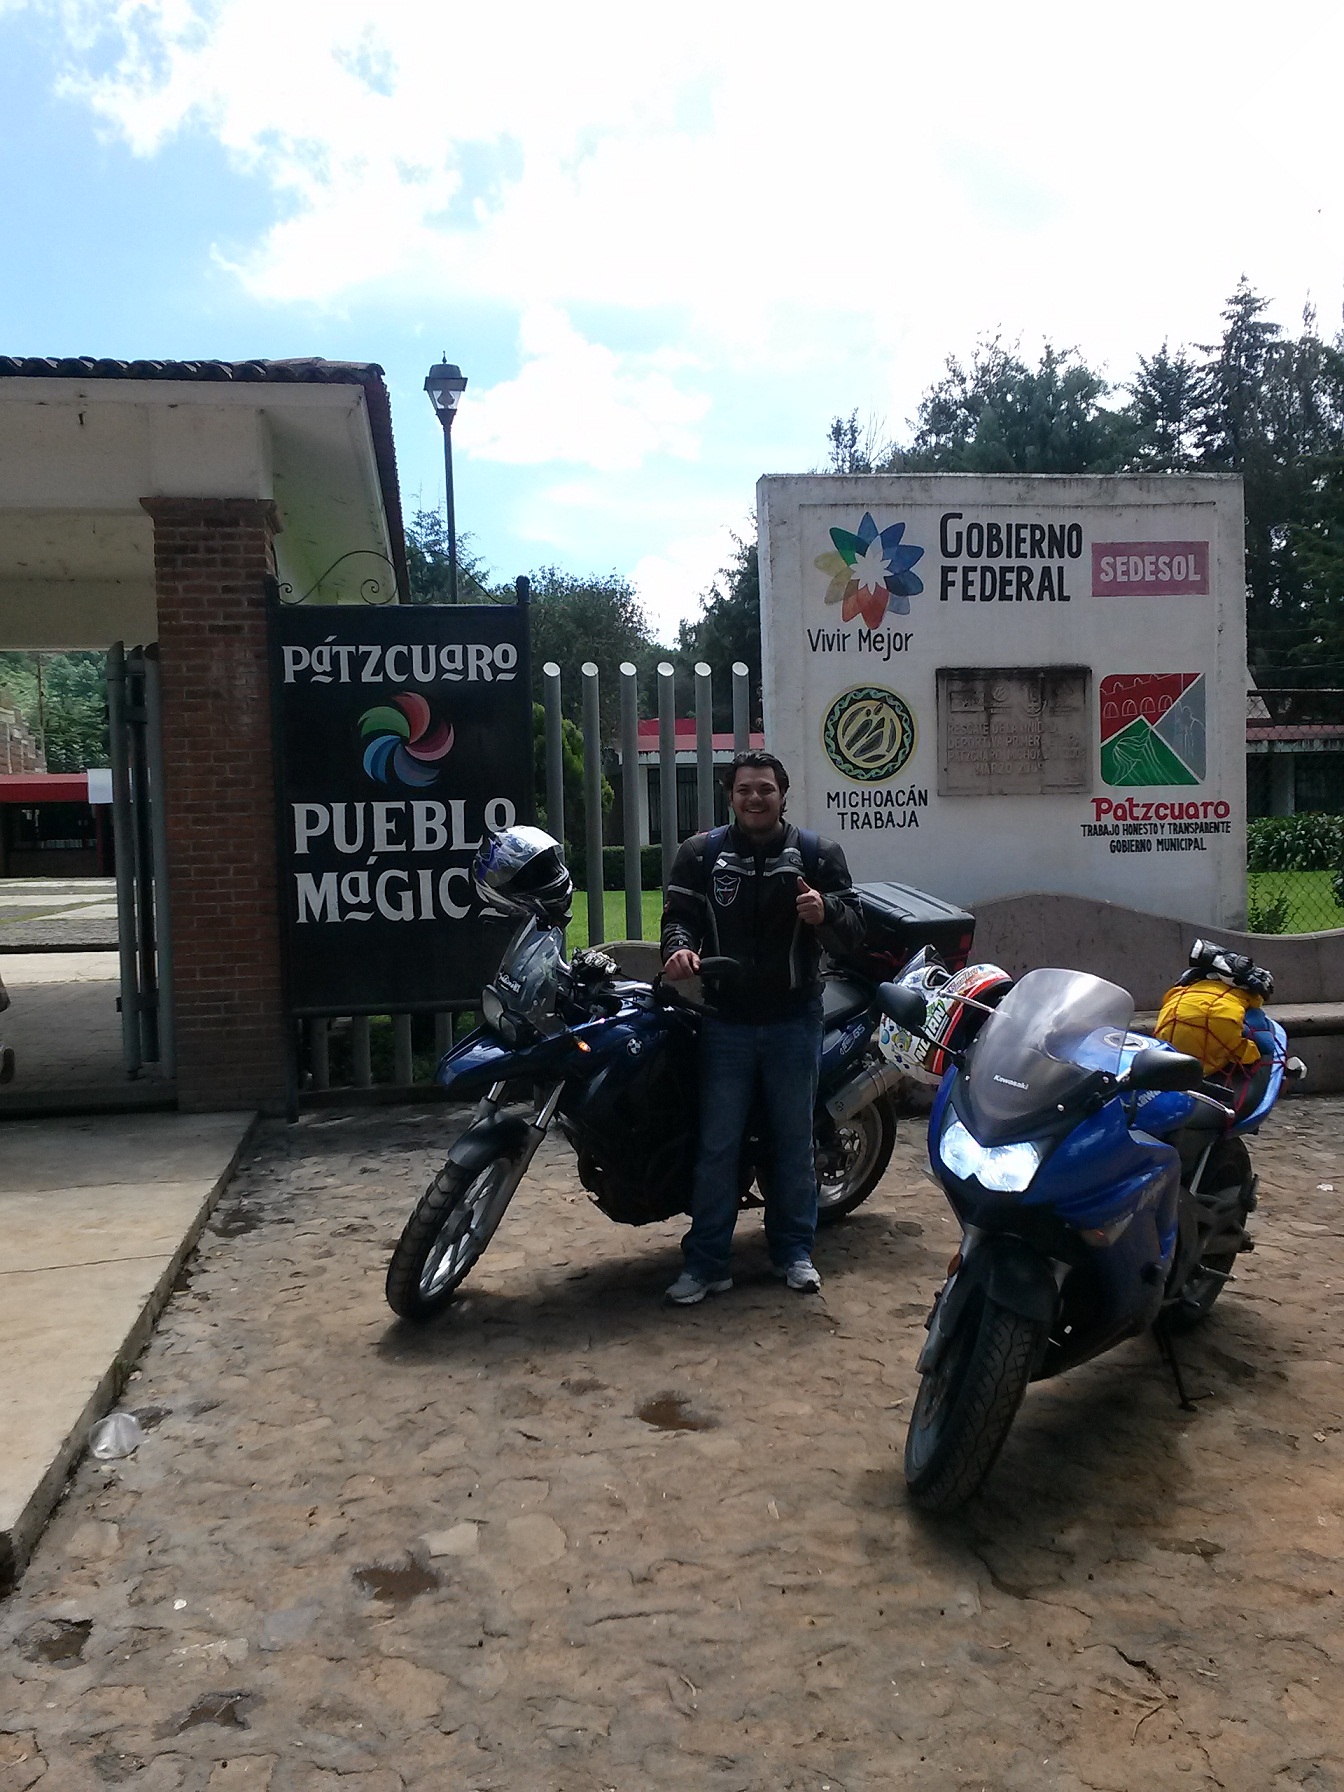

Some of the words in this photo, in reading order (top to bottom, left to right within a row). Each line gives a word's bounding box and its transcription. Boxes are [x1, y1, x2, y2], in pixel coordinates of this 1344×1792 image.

[940, 512, 1083, 559] GOBIERNO
[1099, 555, 1201, 582] SEDESOL
[940, 565, 1071, 601] FEDERAL
[807, 628, 851, 652] Vivir
[858, 628, 913, 661] Mejor
[826, 784, 928, 809] MICHOACÁN
[837, 810, 920, 830] TRABAJA
[1091, 797, 1231, 822] Patzcuaro
[290, 797, 517, 855] PUEBLO
[1081, 823, 1120, 837] TRABAJO
[1122, 823, 1158, 836] HONESTO
[1159, 823, 1166, 835] Y
[1167, 820, 1232, 835] TRANSPARENTE
[1109, 838, 1152, 853] GOBIERNO
[1156, 837, 1207, 852] MUNICIPAL
[993, 1074, 1030, 1090] Kawasaki
